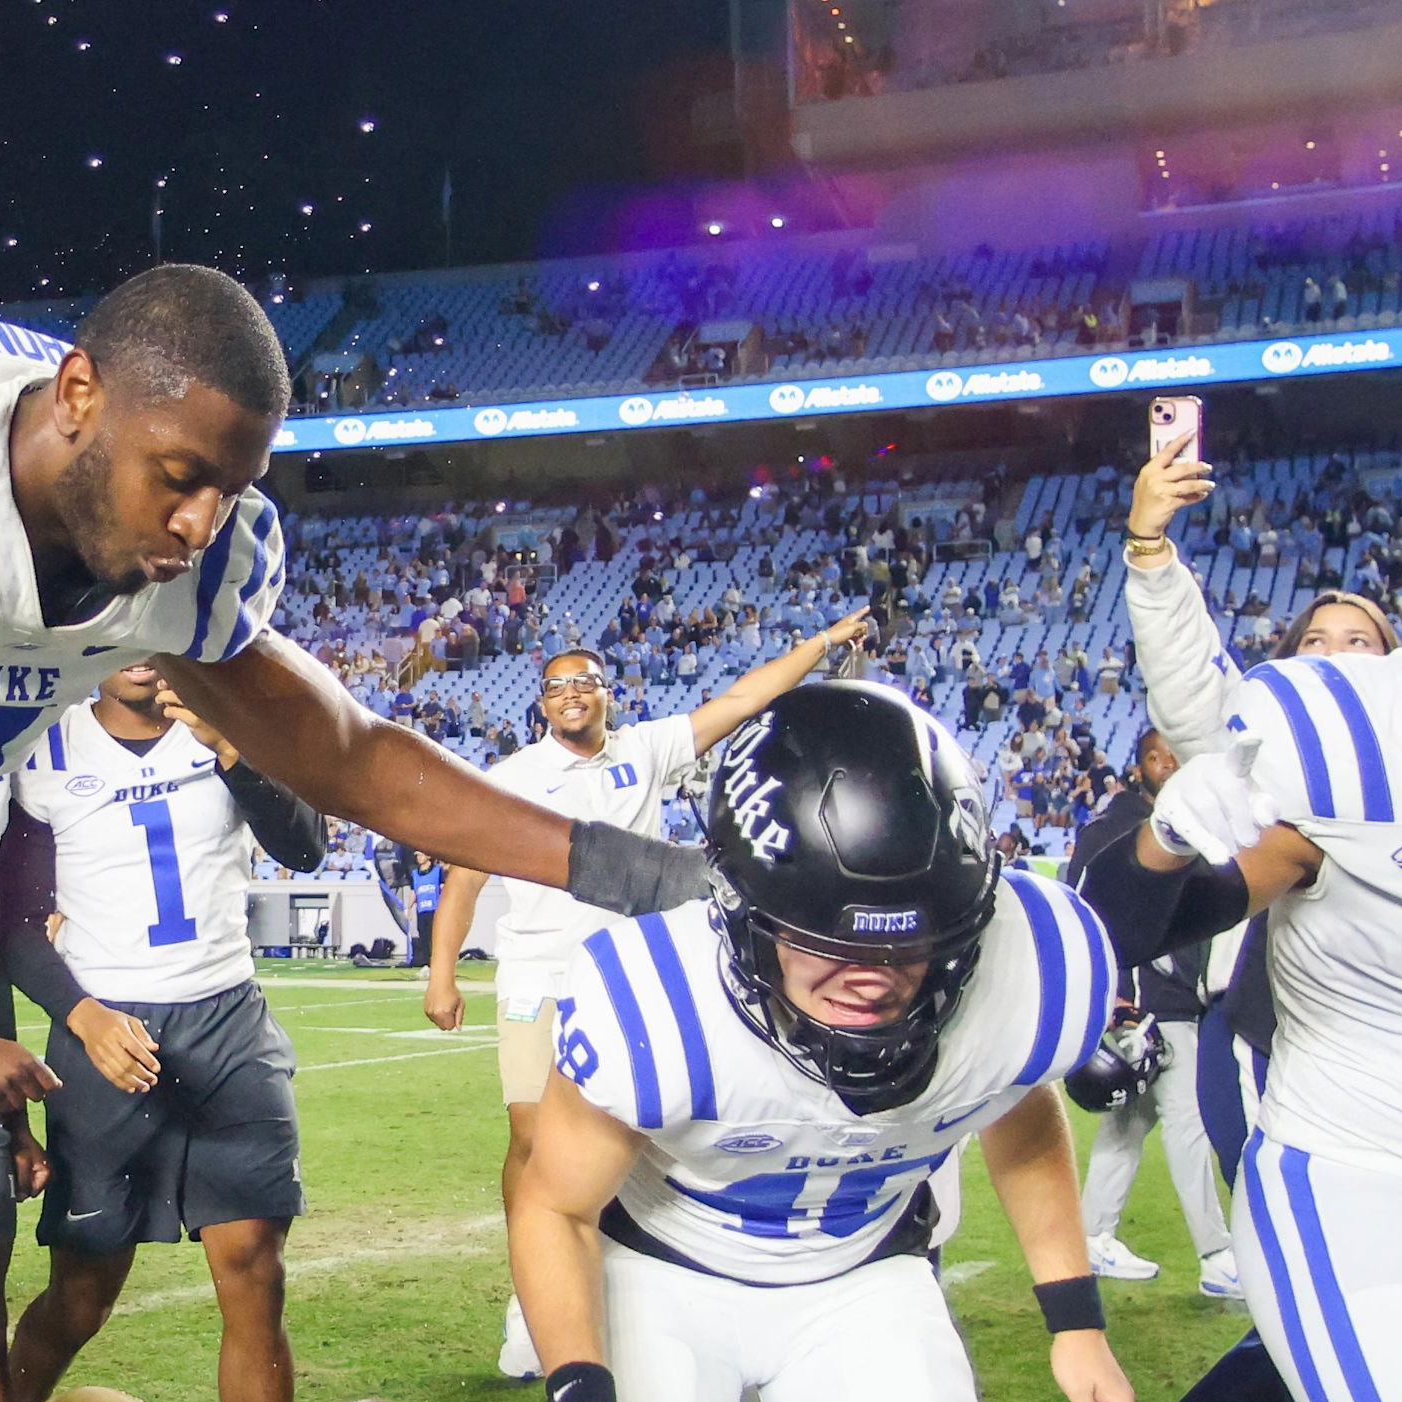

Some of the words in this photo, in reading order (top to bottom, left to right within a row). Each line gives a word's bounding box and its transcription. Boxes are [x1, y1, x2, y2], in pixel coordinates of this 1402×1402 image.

[114, 781, 180, 803] DUKE
[129, 798, 198, 948] 1
[853, 910, 918, 933] DUKE
